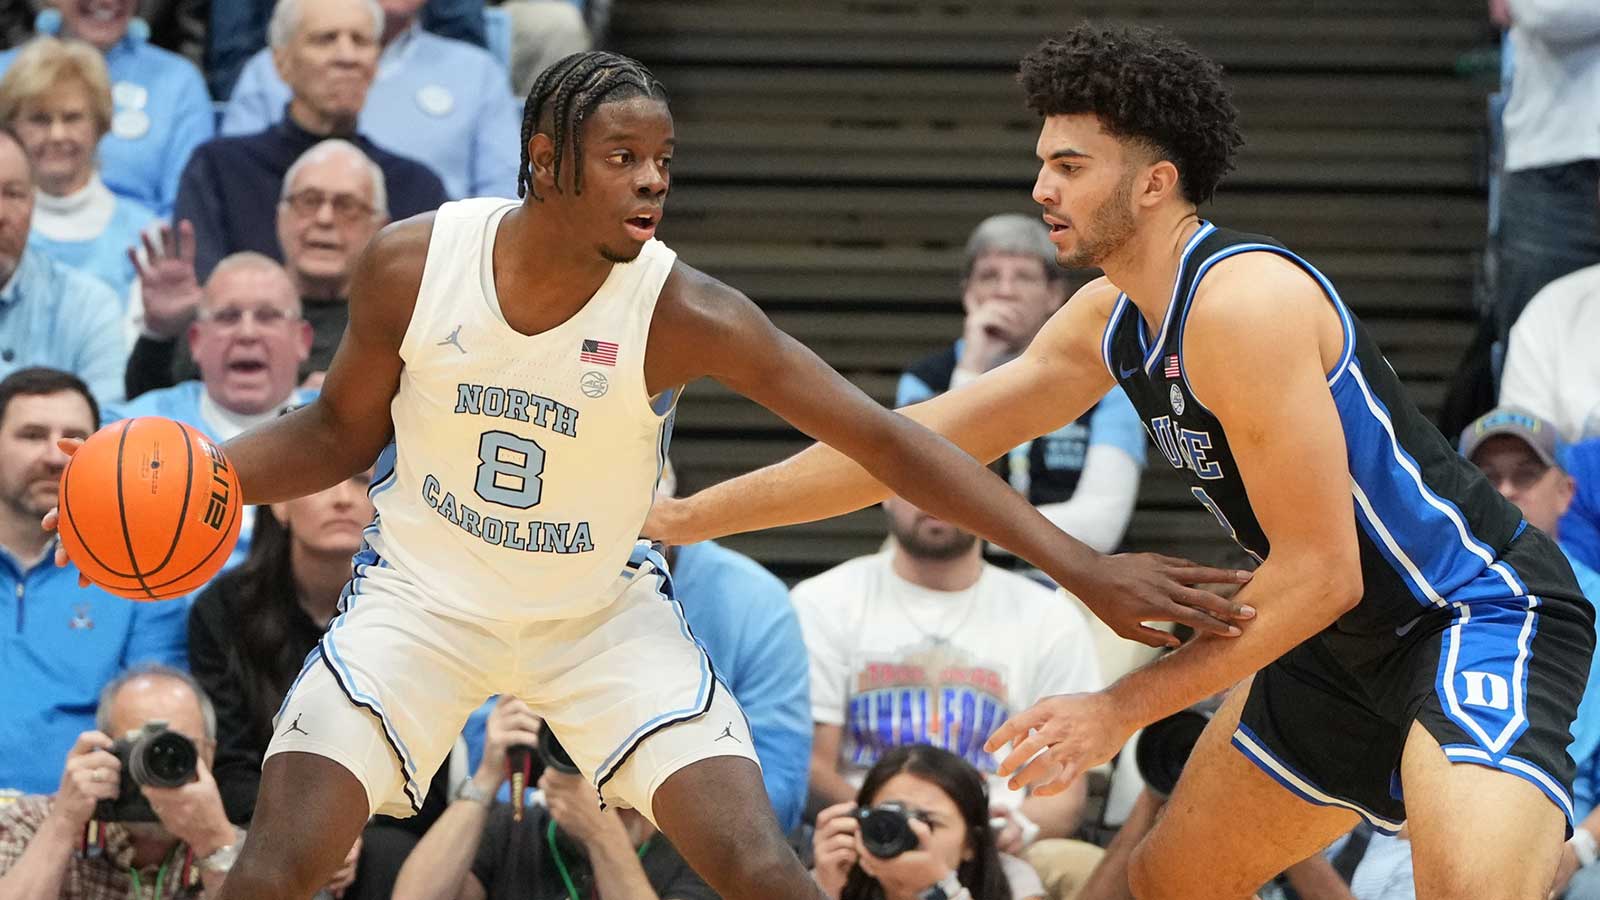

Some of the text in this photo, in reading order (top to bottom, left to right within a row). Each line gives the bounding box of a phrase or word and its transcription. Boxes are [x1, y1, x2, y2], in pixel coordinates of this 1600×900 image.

[454, 383, 579, 438] NORTH
[474, 429, 546, 510] 8
[1145, 415, 1224, 481] UE
[203, 441, 229, 531] ELITE
[421, 474, 594, 554] CAROLINA
[1460, 671, 1508, 710] D
